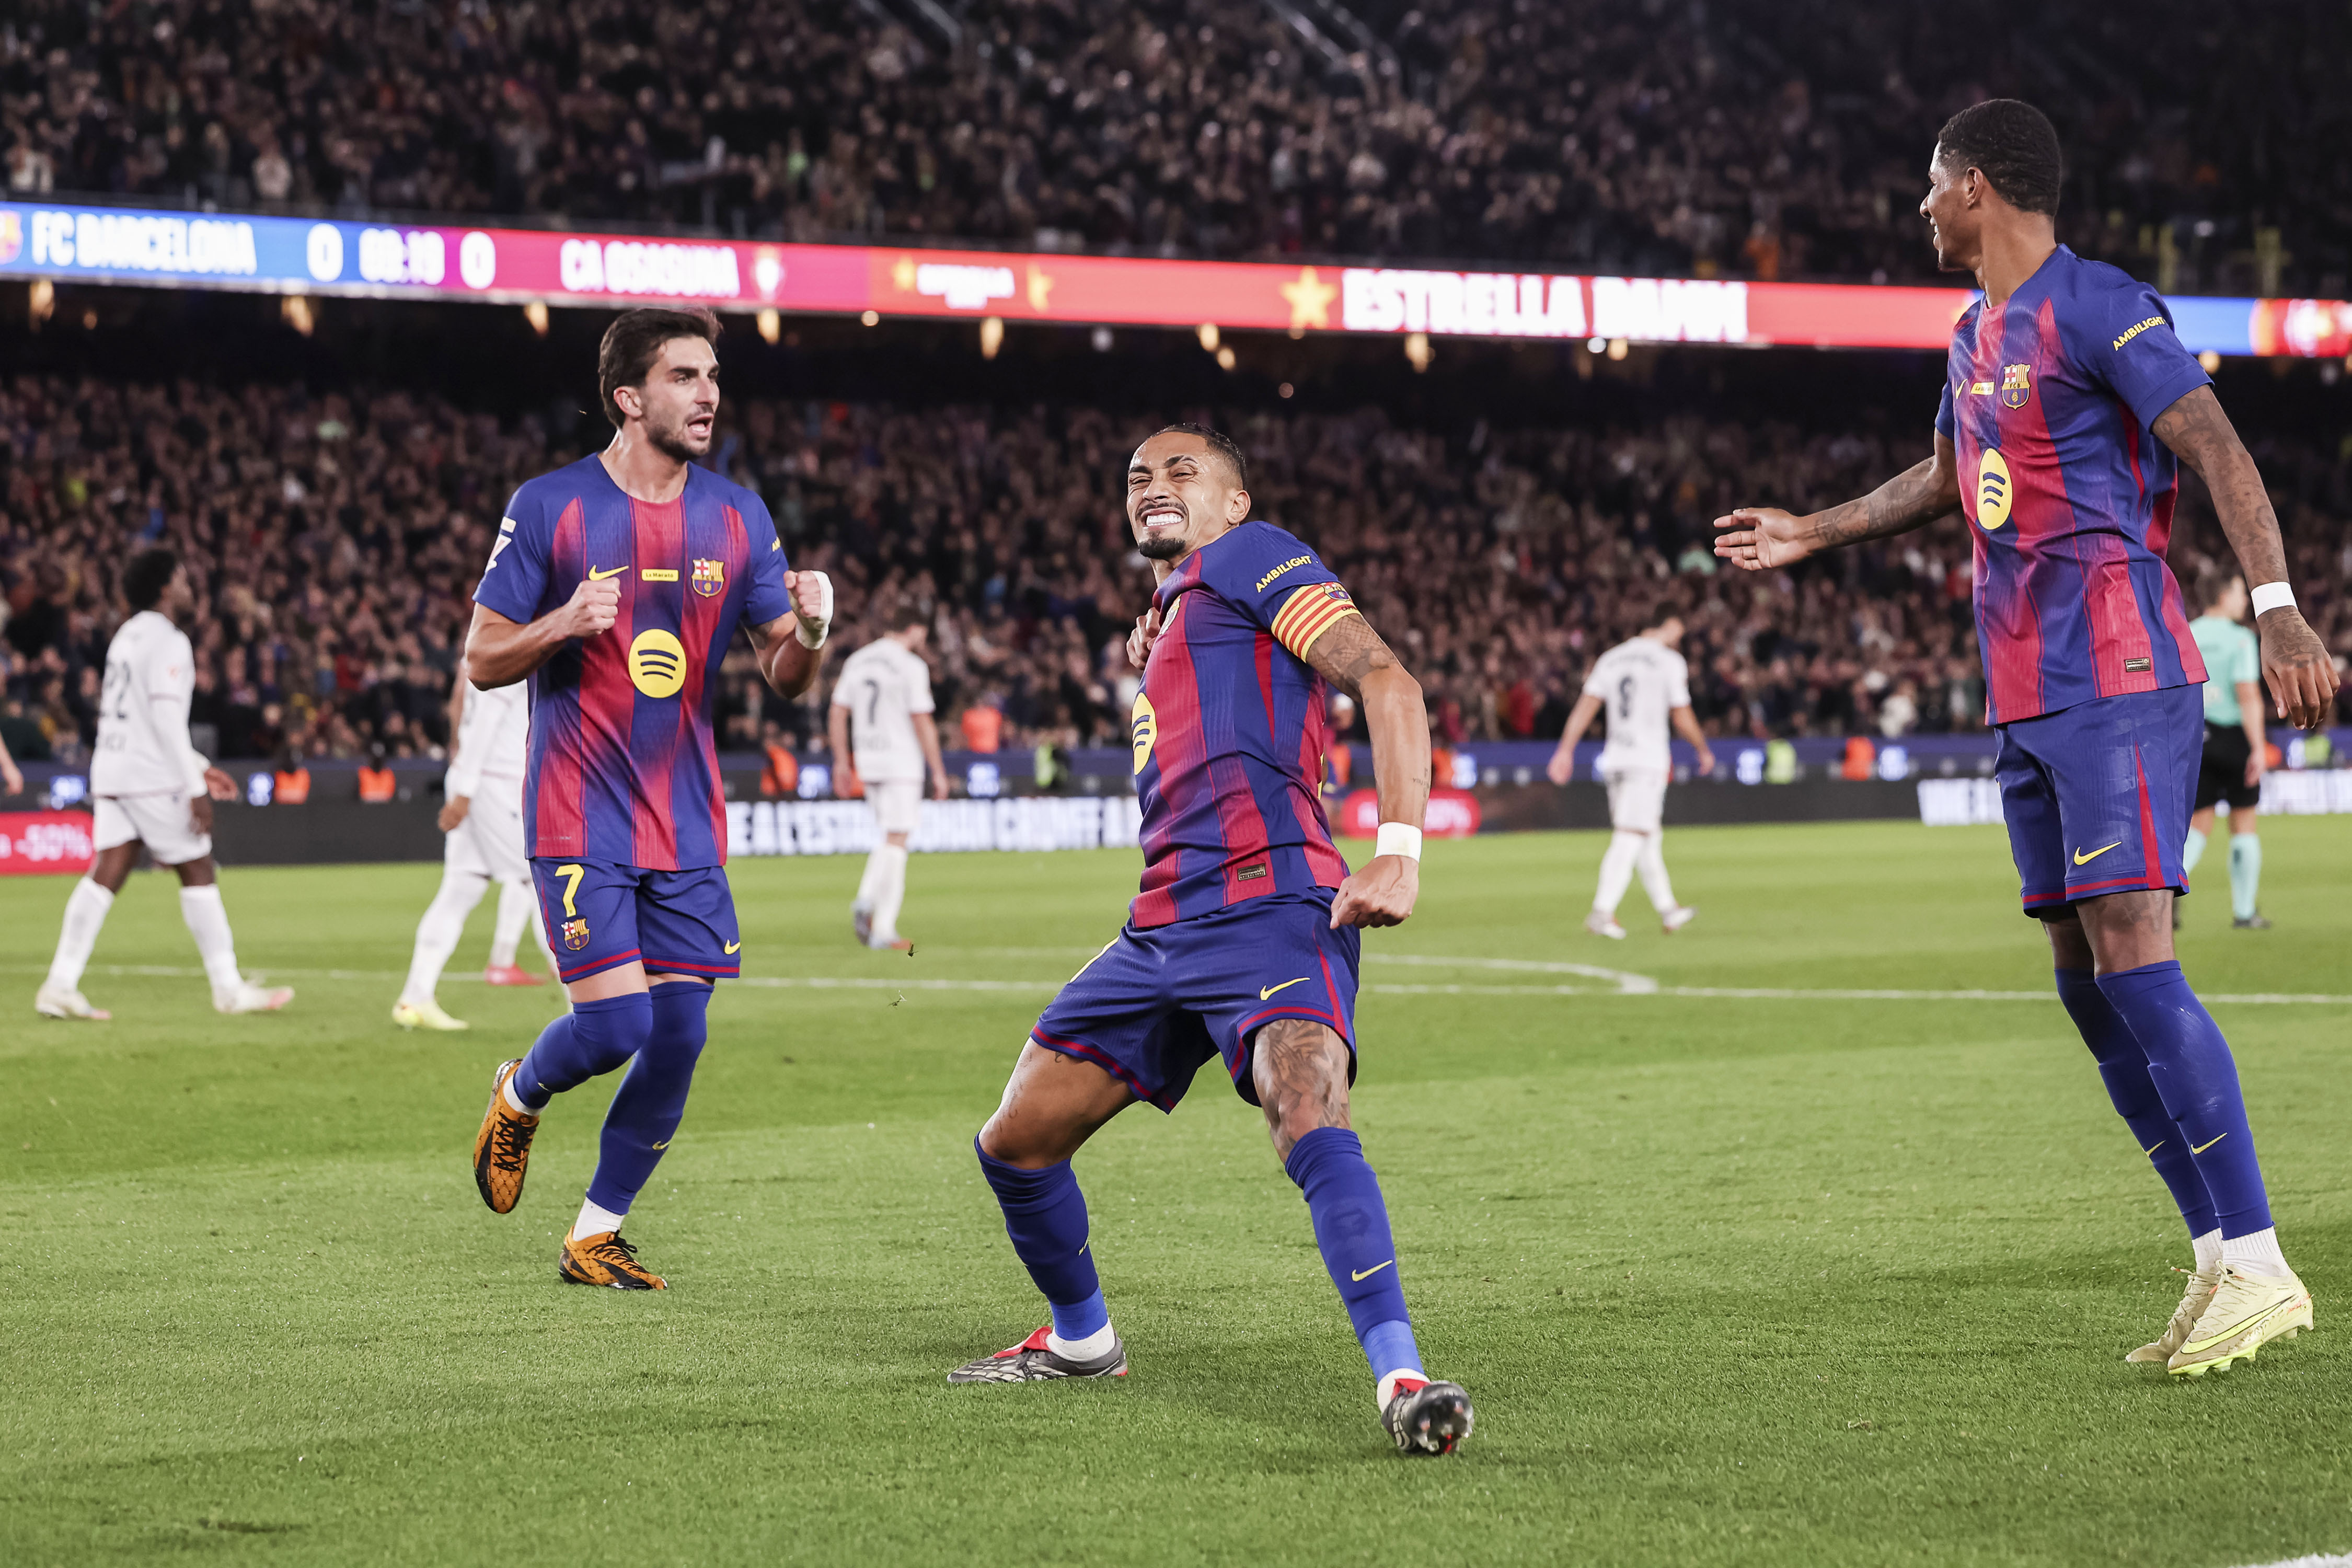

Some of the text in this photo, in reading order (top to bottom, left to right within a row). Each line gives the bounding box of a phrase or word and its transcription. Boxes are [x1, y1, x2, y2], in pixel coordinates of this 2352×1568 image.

[32, 211, 75, 266] FC
[307, 223, 343, 281] 0
[459, 231, 496, 290] 0
[1342, 268, 1587, 338] ESTRELLA
[2113, 316, 2165, 351] AMBILIGHT
[1255, 555, 1312, 593] AMBILIGHT
[863, 678, 880, 726] 7
[555, 863, 585, 917] 7
